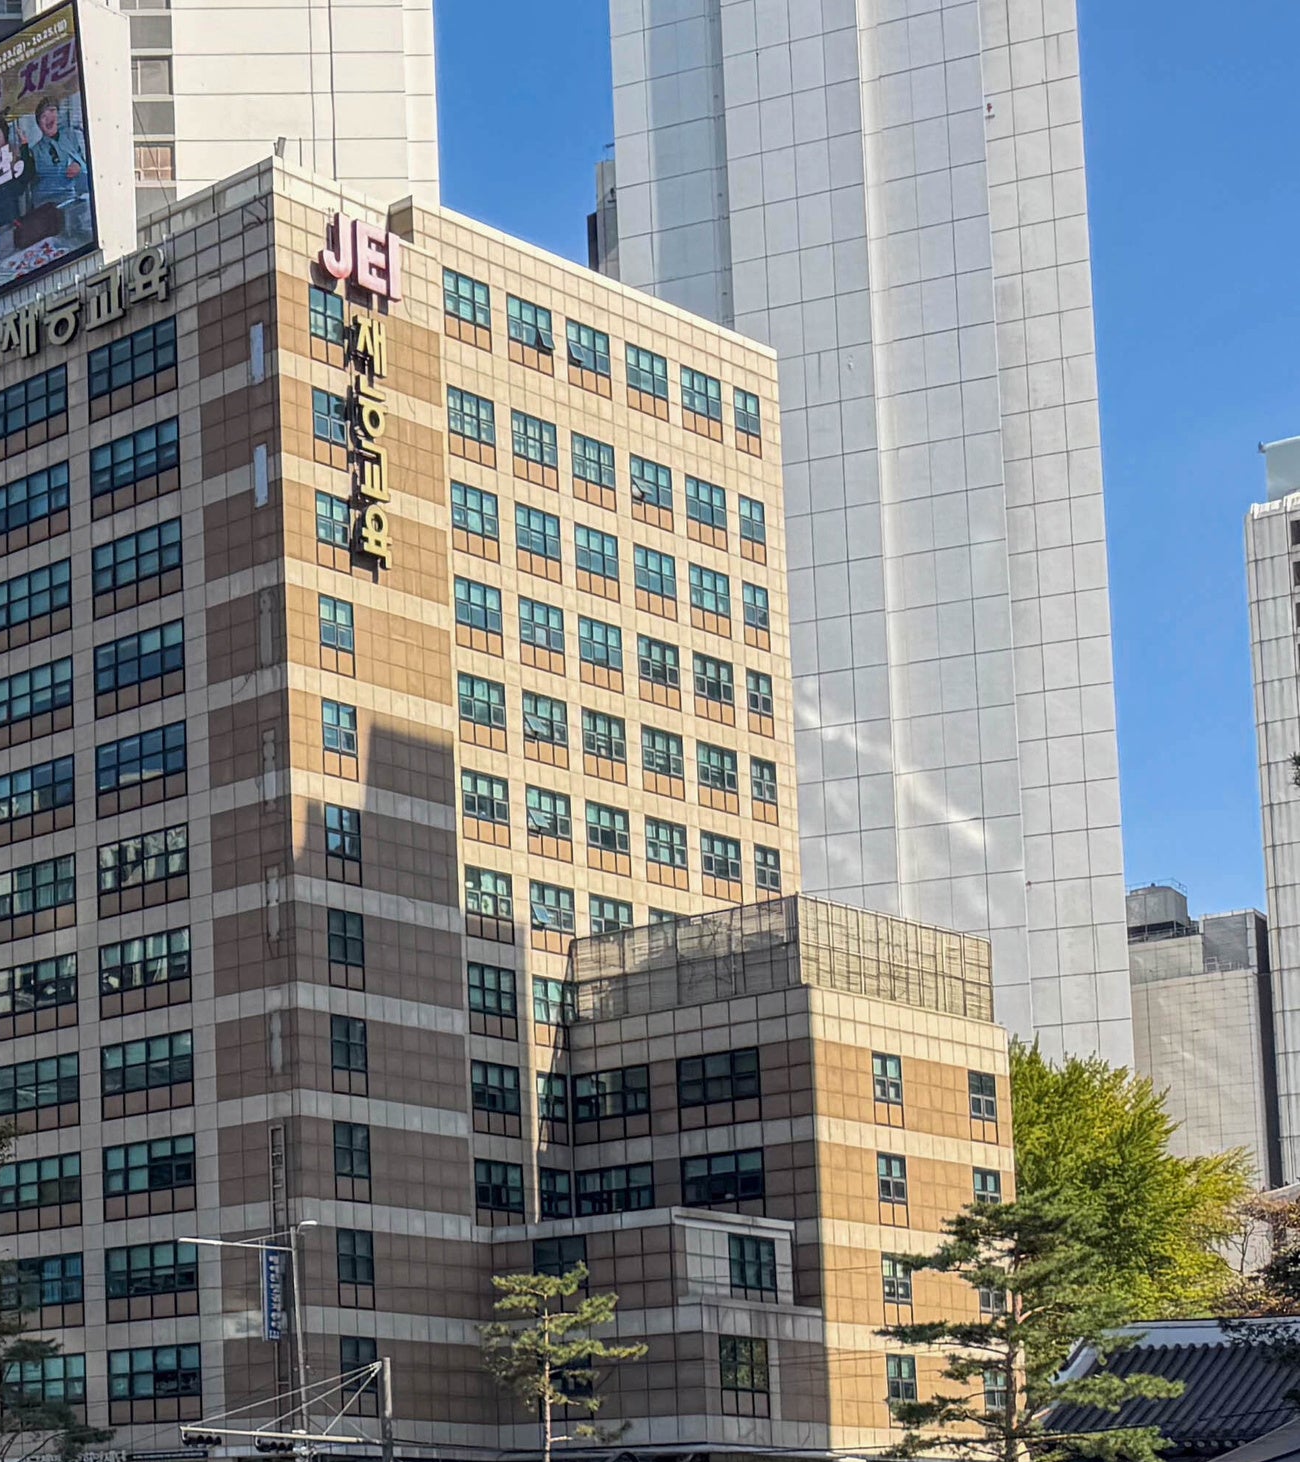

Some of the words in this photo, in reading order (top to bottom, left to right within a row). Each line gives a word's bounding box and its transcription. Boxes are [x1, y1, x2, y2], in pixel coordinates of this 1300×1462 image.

[0, 246, 174, 360] 재능교육
[320, 211, 402, 302] JEI
[353, 313, 393, 571] 재능교육
